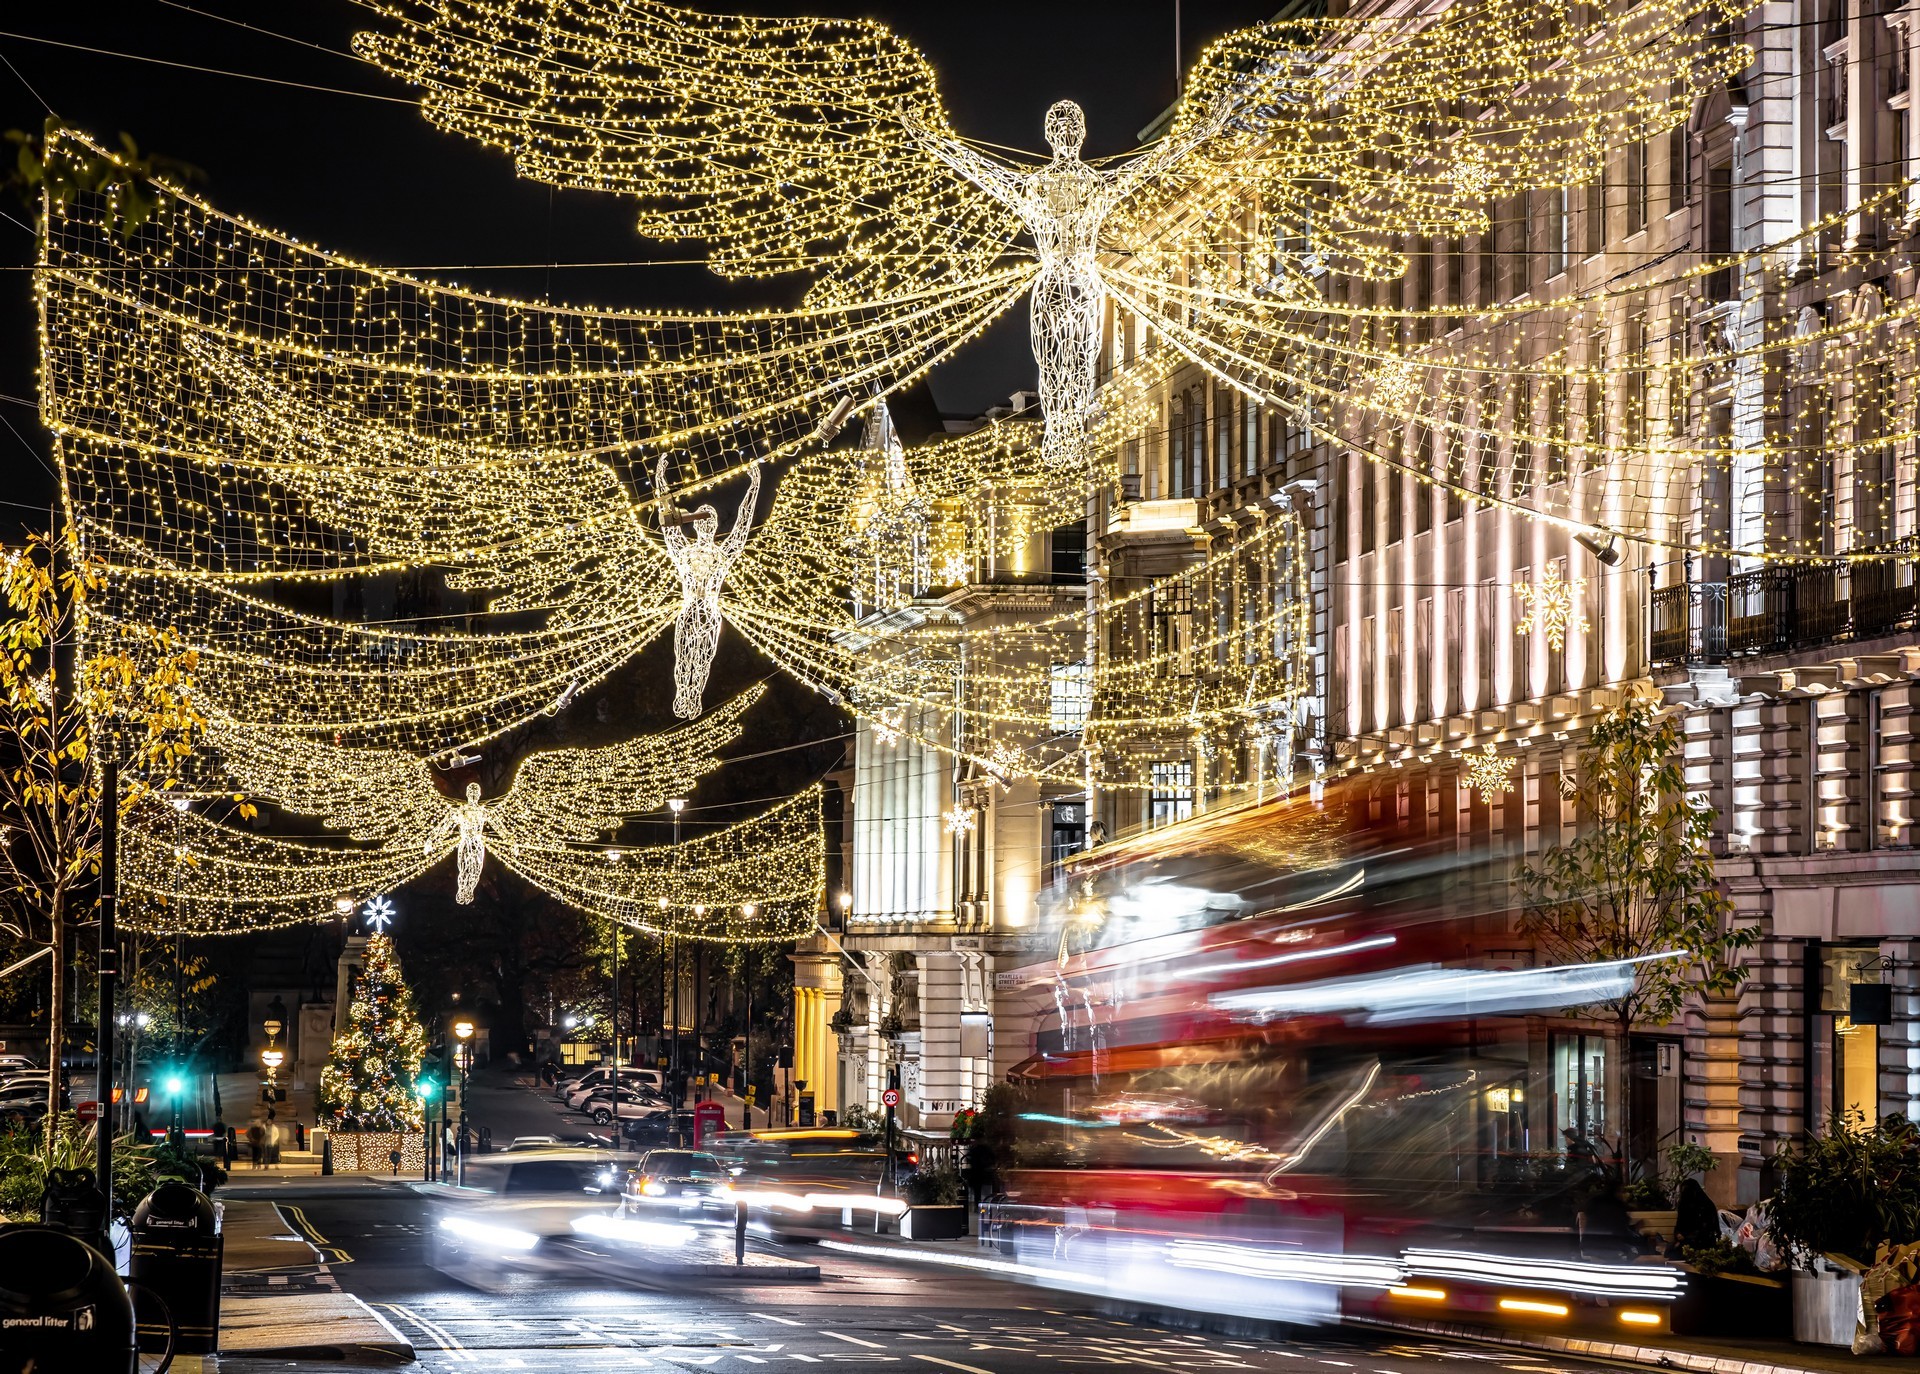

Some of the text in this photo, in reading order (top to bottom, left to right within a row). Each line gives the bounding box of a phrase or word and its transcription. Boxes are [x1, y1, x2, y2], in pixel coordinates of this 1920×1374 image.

[886, 1094, 897, 1102] 20
[2, 1316, 69, 1328] general litter
